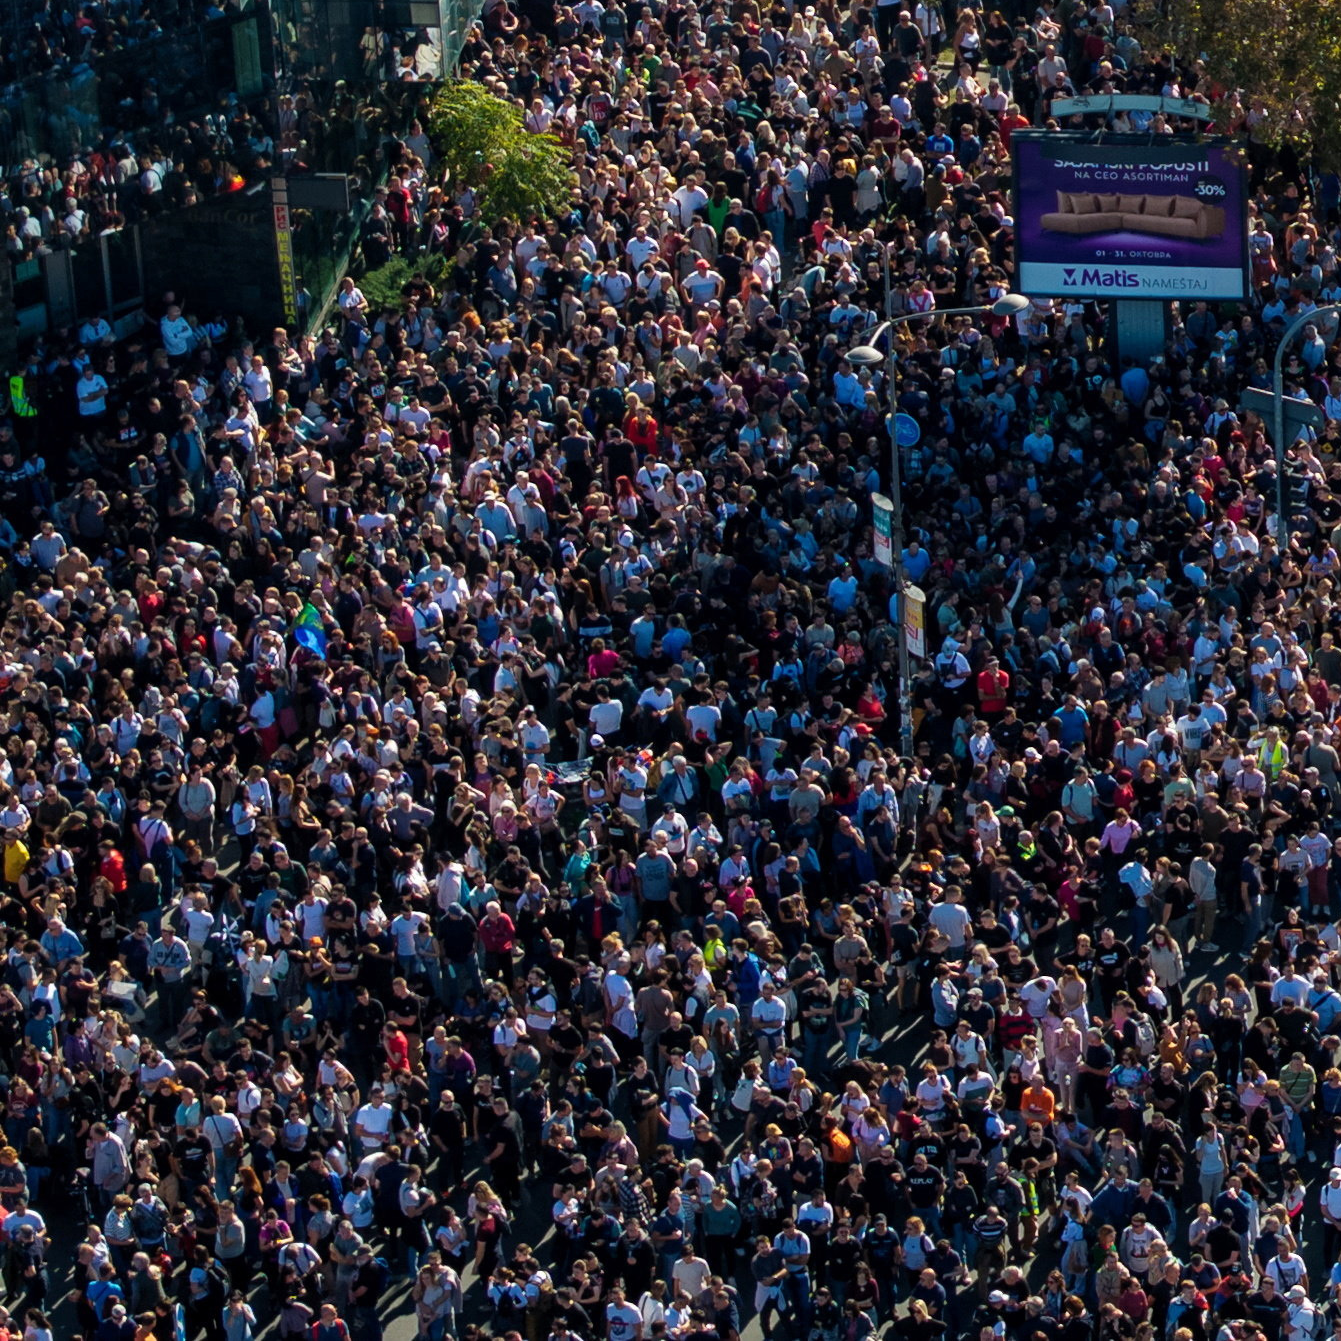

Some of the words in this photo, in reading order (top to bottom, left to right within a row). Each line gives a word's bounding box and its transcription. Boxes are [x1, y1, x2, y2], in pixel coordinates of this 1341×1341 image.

[1074, 170, 1091, 179] NA
[1094, 170, 1119, 180] CEO
[1122, 171, 1189, 182] ASORTIMAN
[1129, 250, 1172, 259] OKTOBRA
[1081, 268, 1140, 288] Matis
